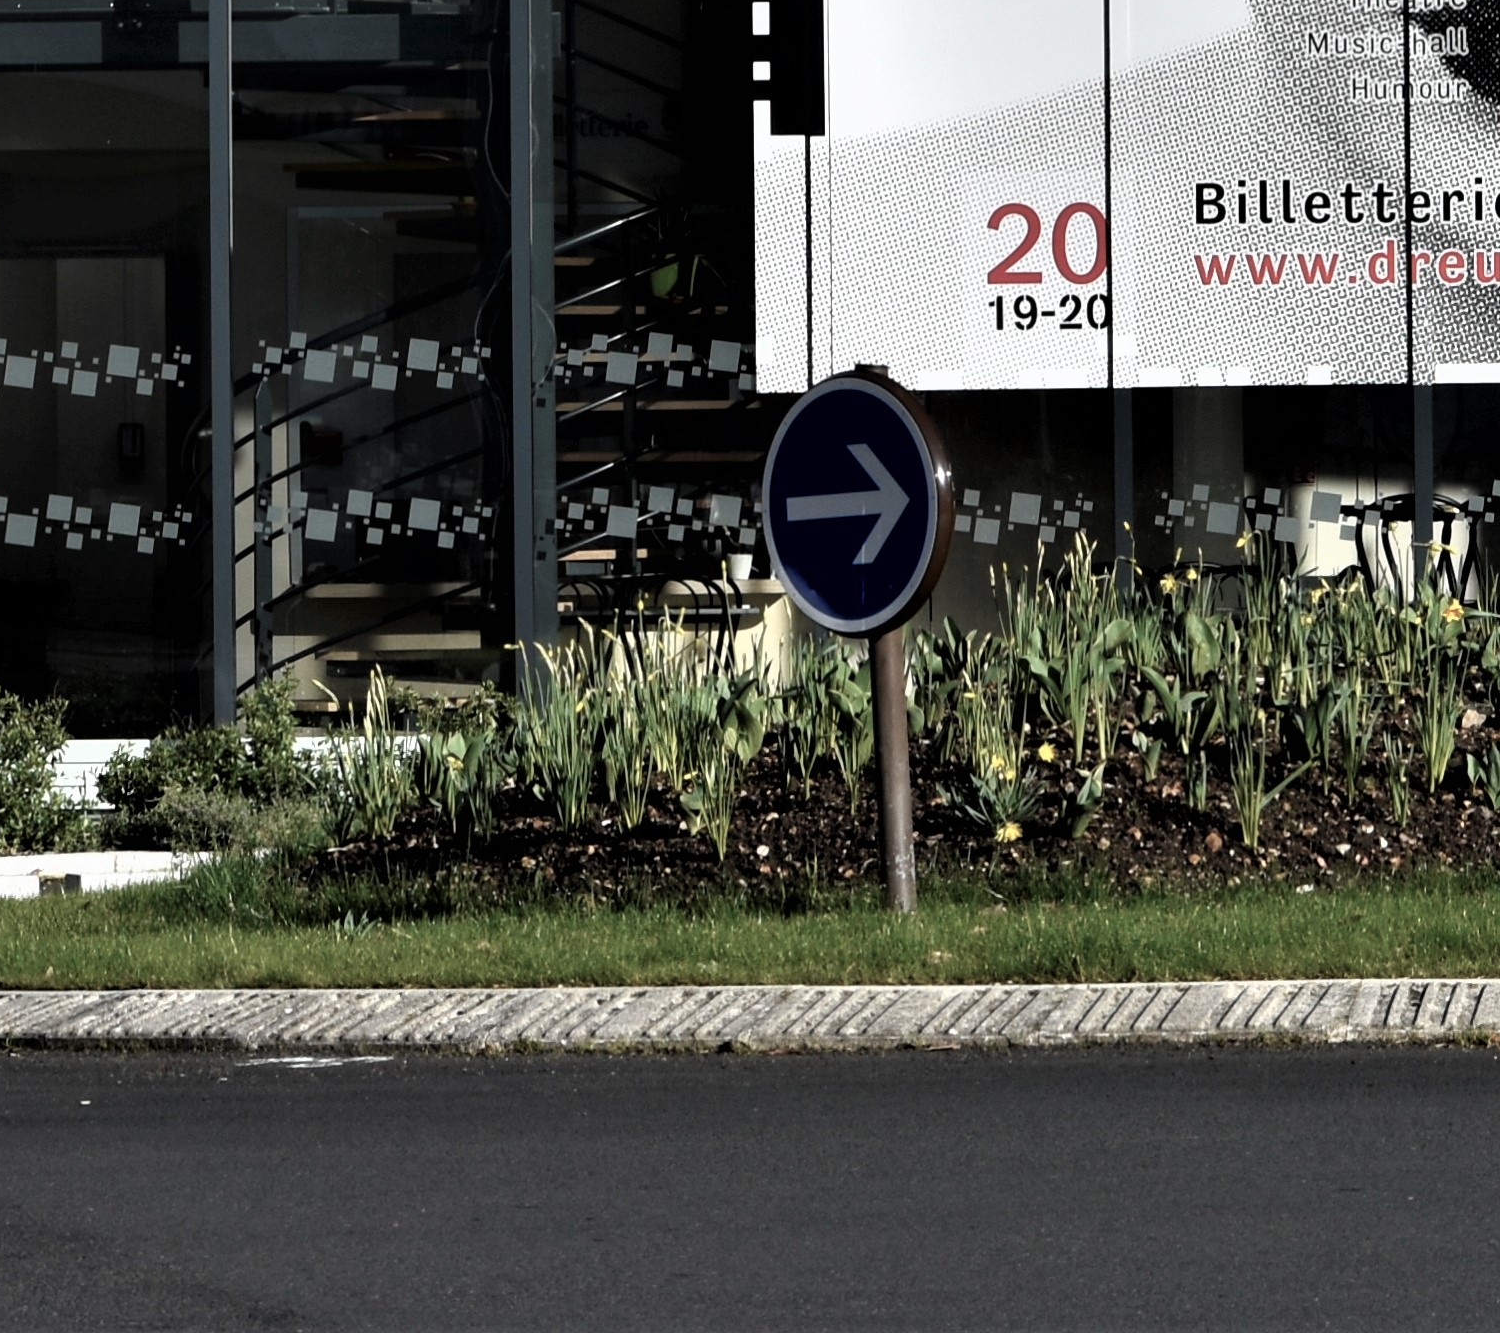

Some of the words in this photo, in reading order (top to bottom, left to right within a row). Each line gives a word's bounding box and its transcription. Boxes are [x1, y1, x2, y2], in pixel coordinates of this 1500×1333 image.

[1308, 27, 1469, 55] Music-hall
[1352, 77, 1467, 100] Humour
[987, 201, 1109, 285] 20
[988, 294, 1111, 331] 19-20
